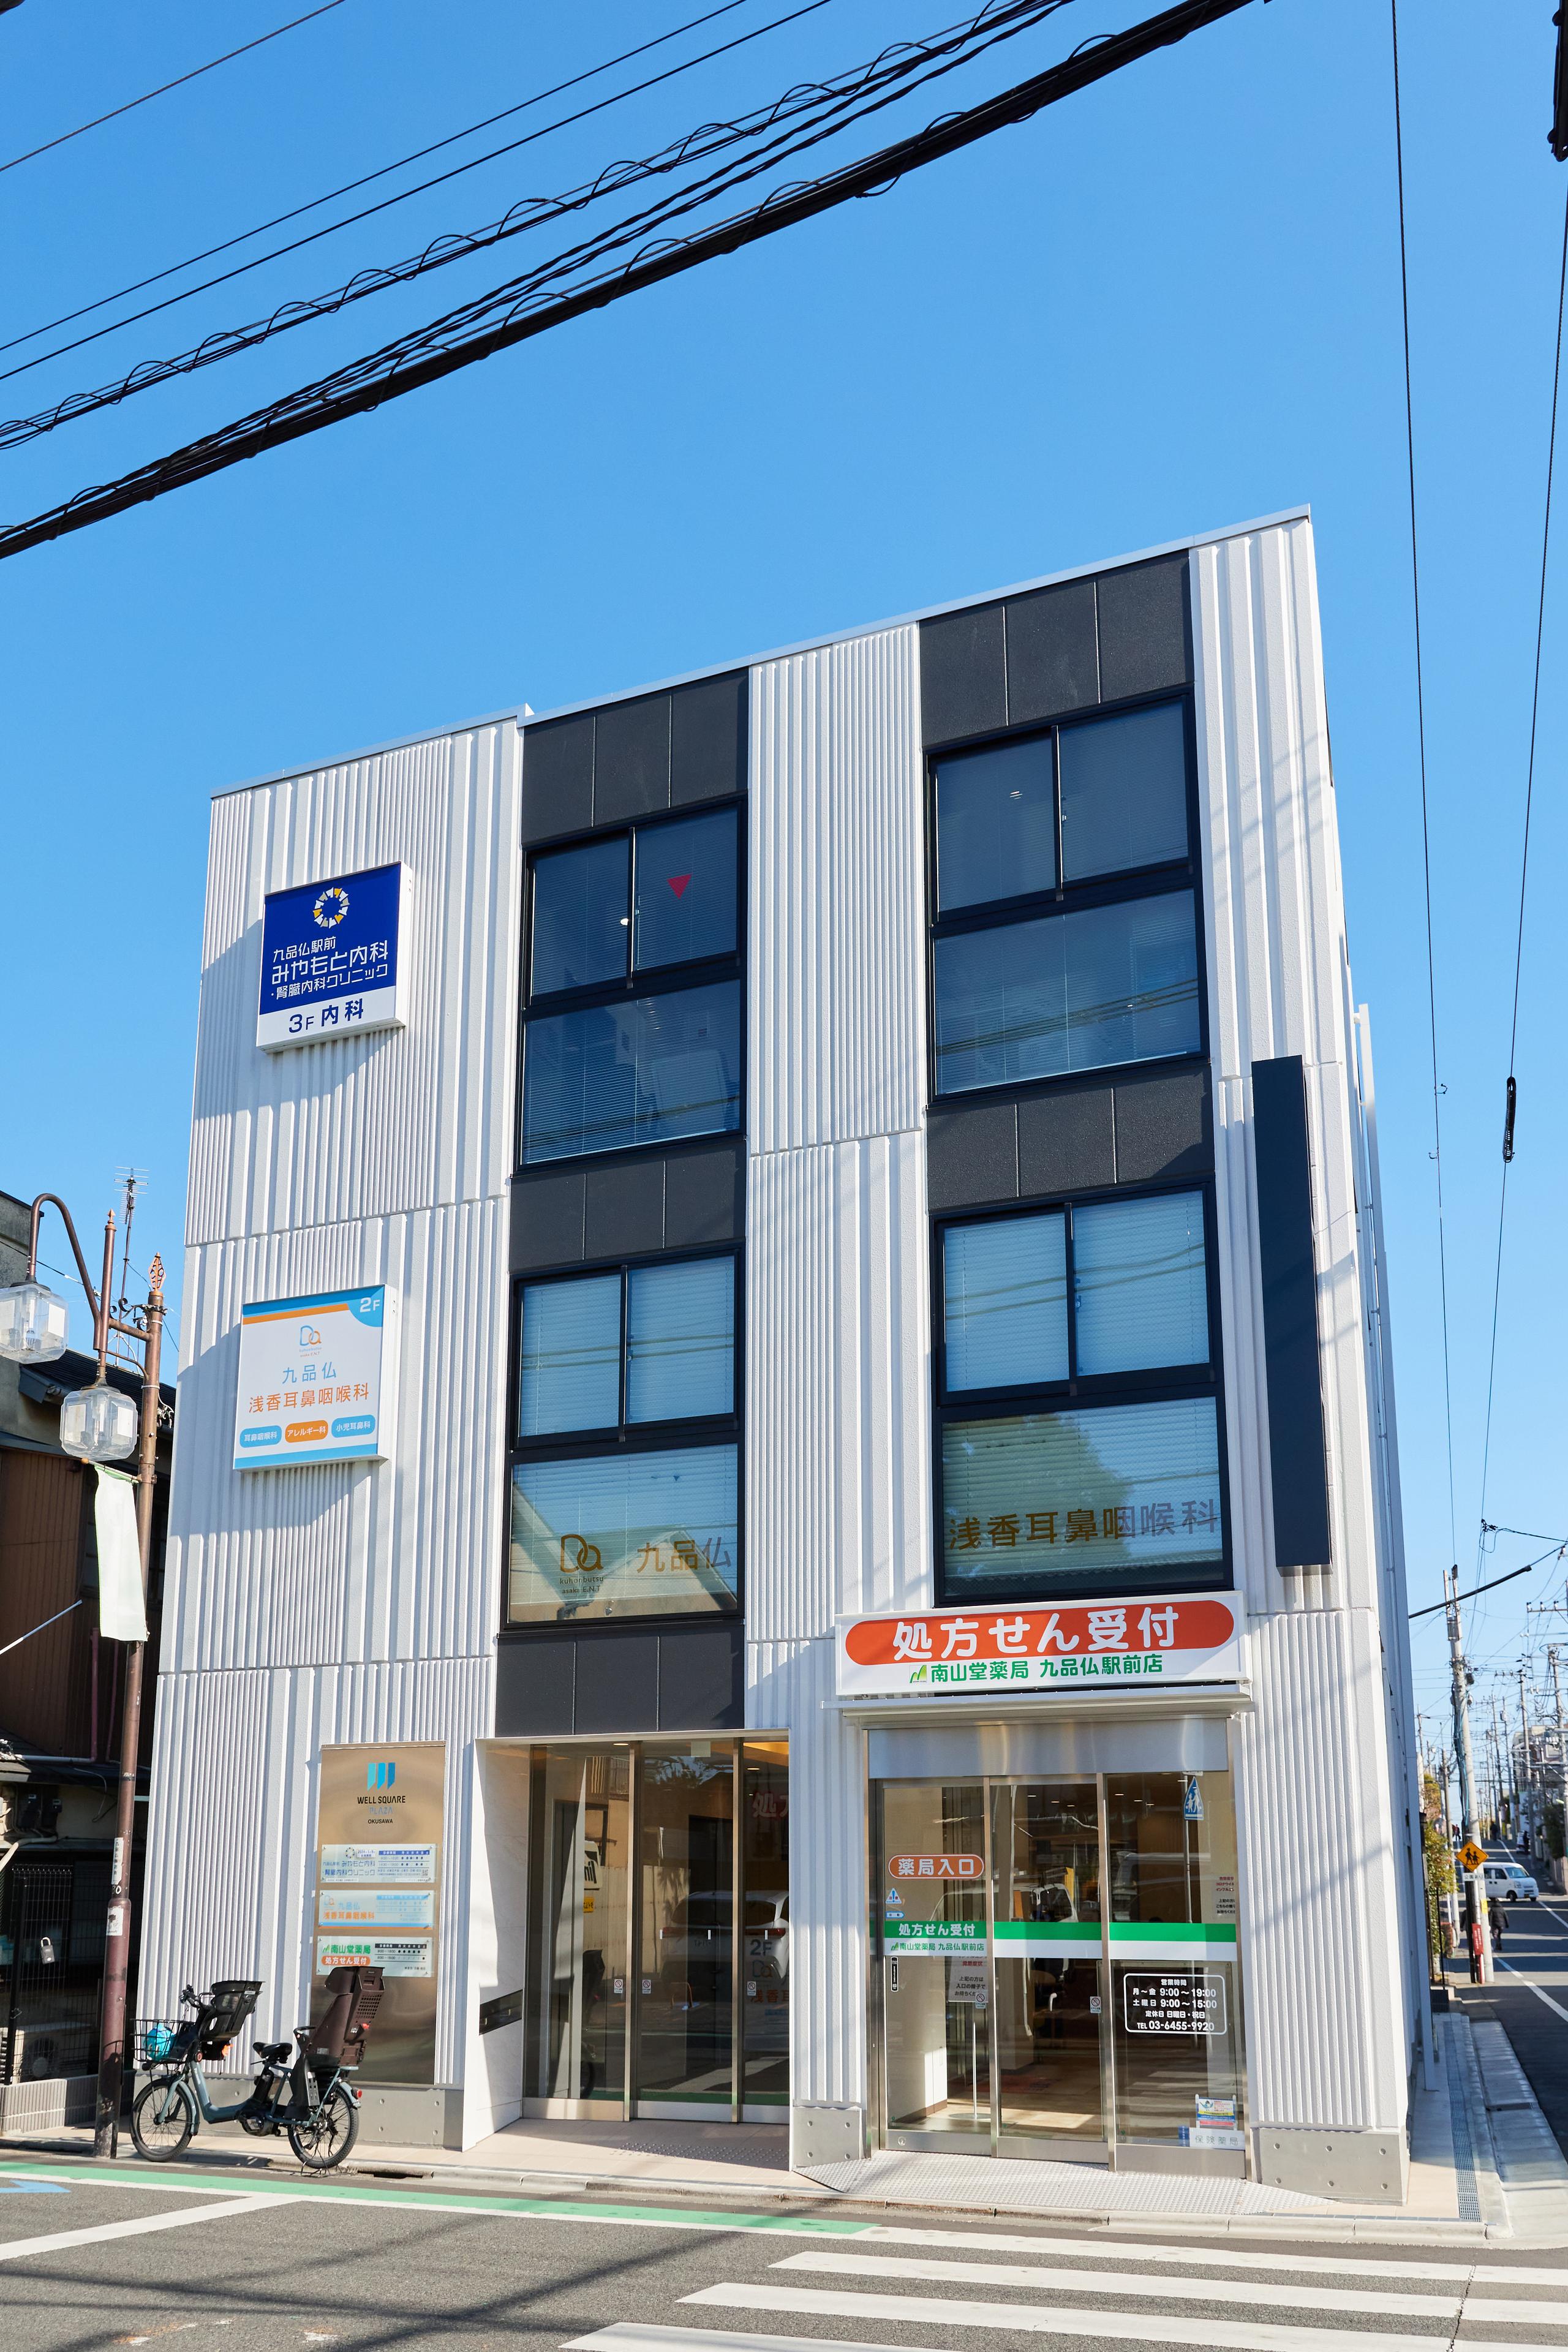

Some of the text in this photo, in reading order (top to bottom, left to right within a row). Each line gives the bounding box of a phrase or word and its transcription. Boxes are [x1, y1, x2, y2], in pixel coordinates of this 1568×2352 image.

[273, 935, 336, 963] 九品仏駅前
[271, 940, 389, 986] みやもと内科
[288, 998, 364, 1033] 3F 内科
[359, 1297, 380, 1313] 2F
[281, 1361, 336, 1384] 九品仏
[248, 1382, 369, 1414] 浅香耳鼻咽喉科
[287, 1425, 326, 1437] アレルギー科
[336, 1420, 371, 1432] 小児耳鼻科
[949, 1498, 1215, 1551] 浅香耳鼻咽喉科
[636, 1536, 732, 1574] 九品仏
[559, 1576, 604, 1585] kuhonbutsu
[892, 1605, 1180, 1662] 処方せん受付
[930, 1653, 1163, 1684] 南山堂薬局 九品仏駅前店
[357, 1795, 406, 1804] WELL SQUARE
[369, 1806, 393, 1815] PLAZA
[898, 1858, 974, 1875] 薬局入口
[337, 1901, 360, 1910] 九品仏
[898, 1923, 976, 1936] 処方せん受付
[331, 1944, 371, 1954] 南山堂薬局
[899, 1942, 984, 1951] 南山堂薬局 九品仏駅前店
[325, 1956, 368, 1965] 処方せん受付
[1133, 1999, 1156, 2007] 土曜日
[1148, 2021, 1215, 2031] 03-6455-9920
[1195, 2135, 1238, 2146] 保険薬局
